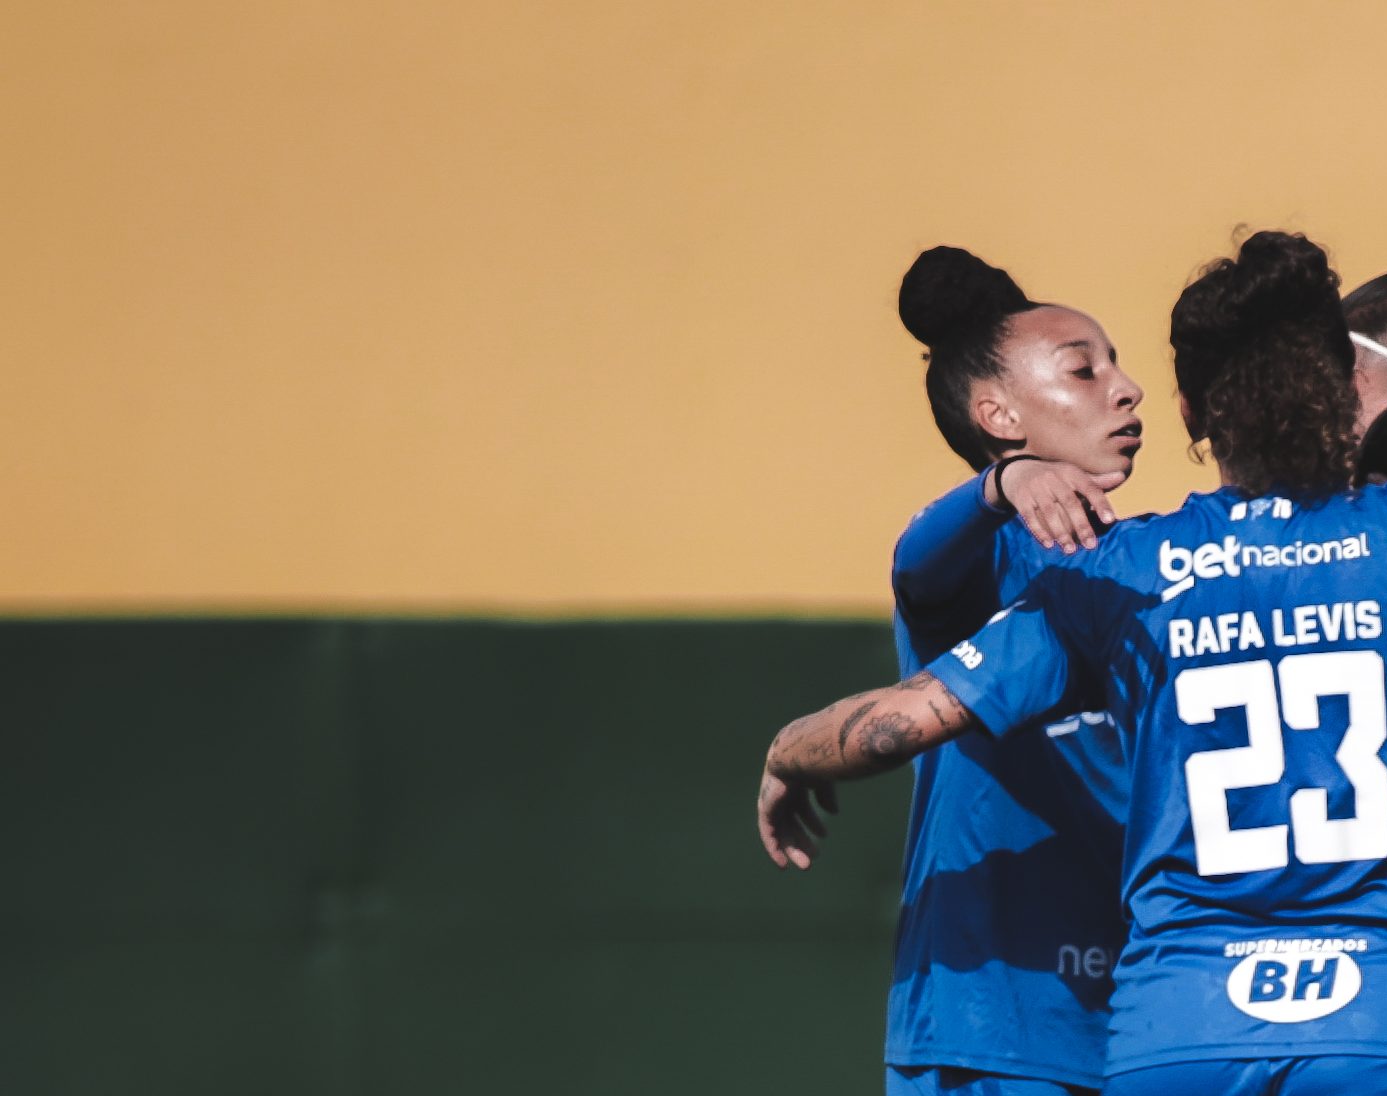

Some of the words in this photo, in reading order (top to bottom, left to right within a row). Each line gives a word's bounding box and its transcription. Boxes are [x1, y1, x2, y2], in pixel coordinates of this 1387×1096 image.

[1168, 610, 1265, 659] RAFA
[1272, 599, 1383, 647] LEVIS
[1224, 938, 1369, 957] SUPERMERCADOS
[1248, 957, 1340, 1004] BH
